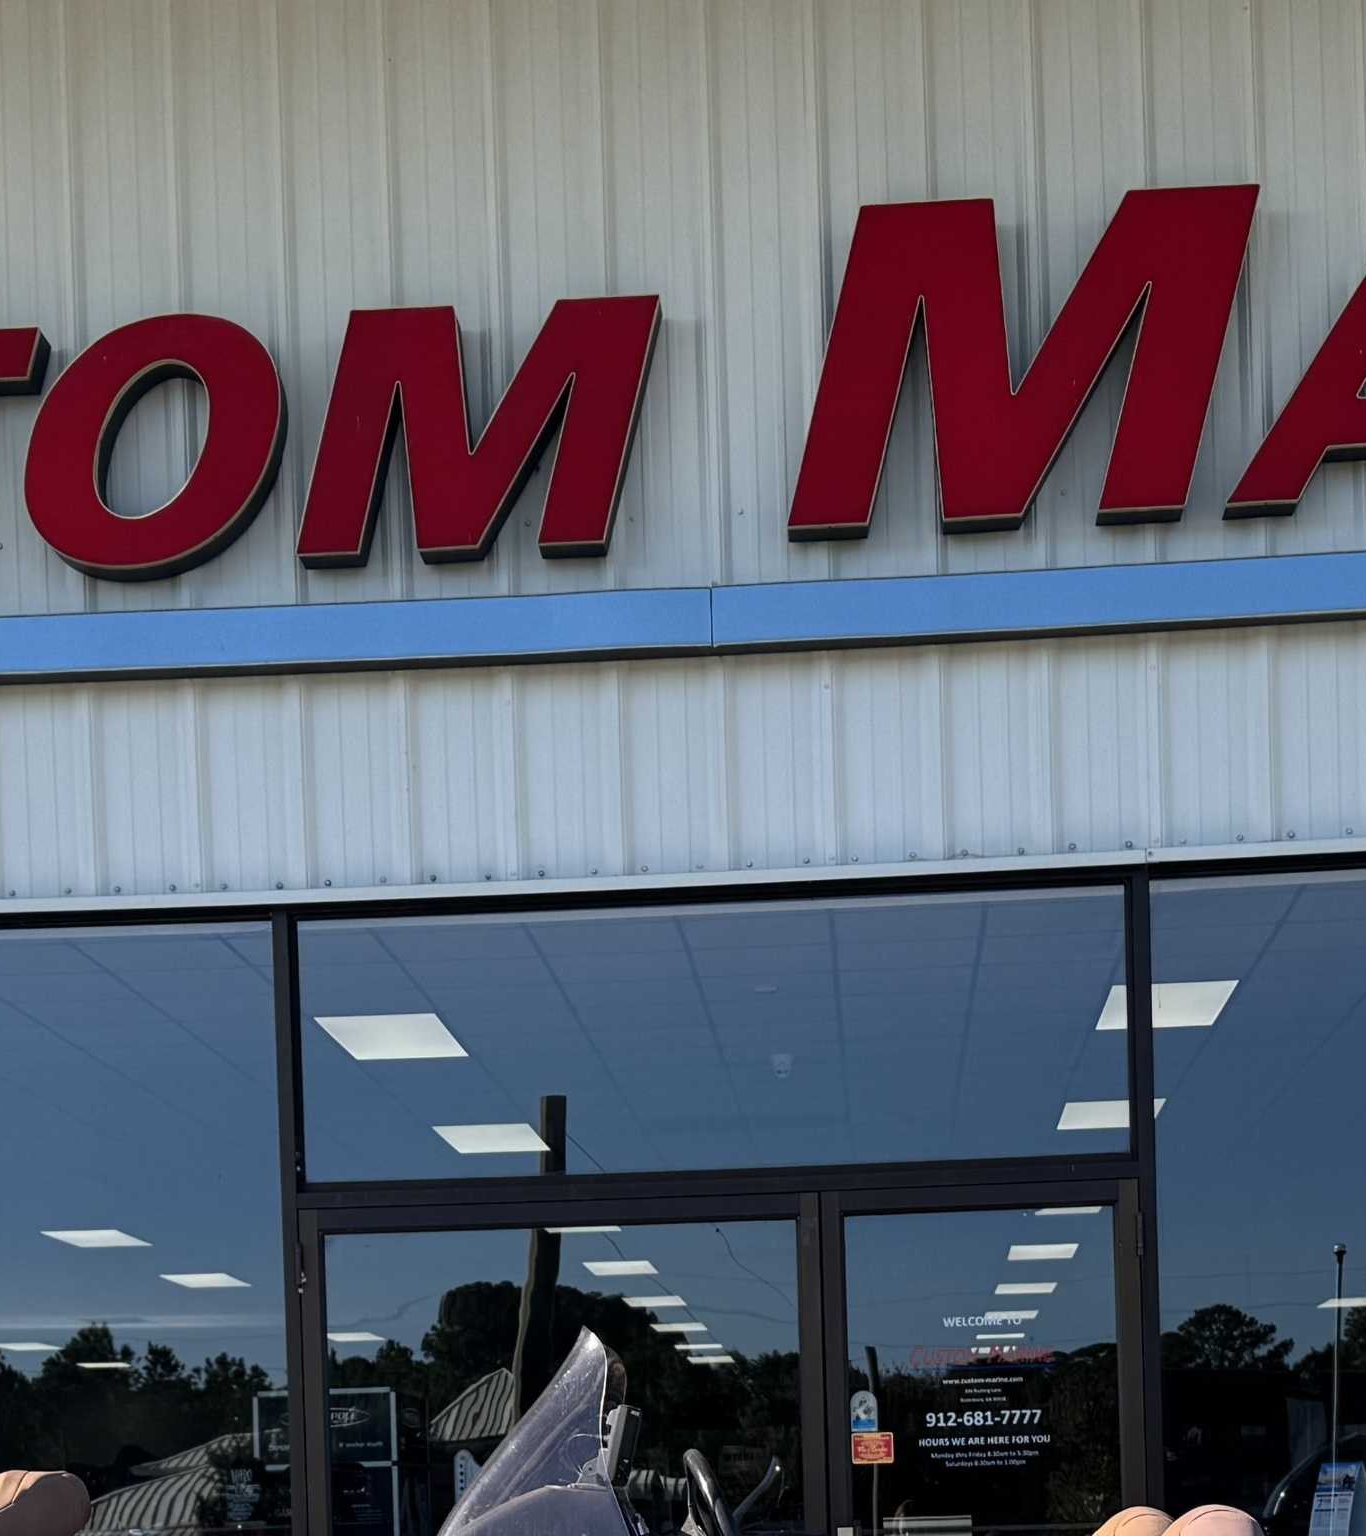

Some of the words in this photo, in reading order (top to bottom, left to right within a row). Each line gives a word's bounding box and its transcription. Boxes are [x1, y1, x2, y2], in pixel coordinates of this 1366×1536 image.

[942, 1315, 1003, 1328] WELCOME
[925, 1409, 1042, 1428] 912-681-7777
[918, 1437, 950, 1448] HOURS
[951, 1437, 966, 1446] WE
[968, 1436, 985, 1446] ARE
[987, 1435, 1010, 1445] HERE
[1012, 1434, 1030, 1444] FOR
[1031, 1434, 1051, 1444] YOU
